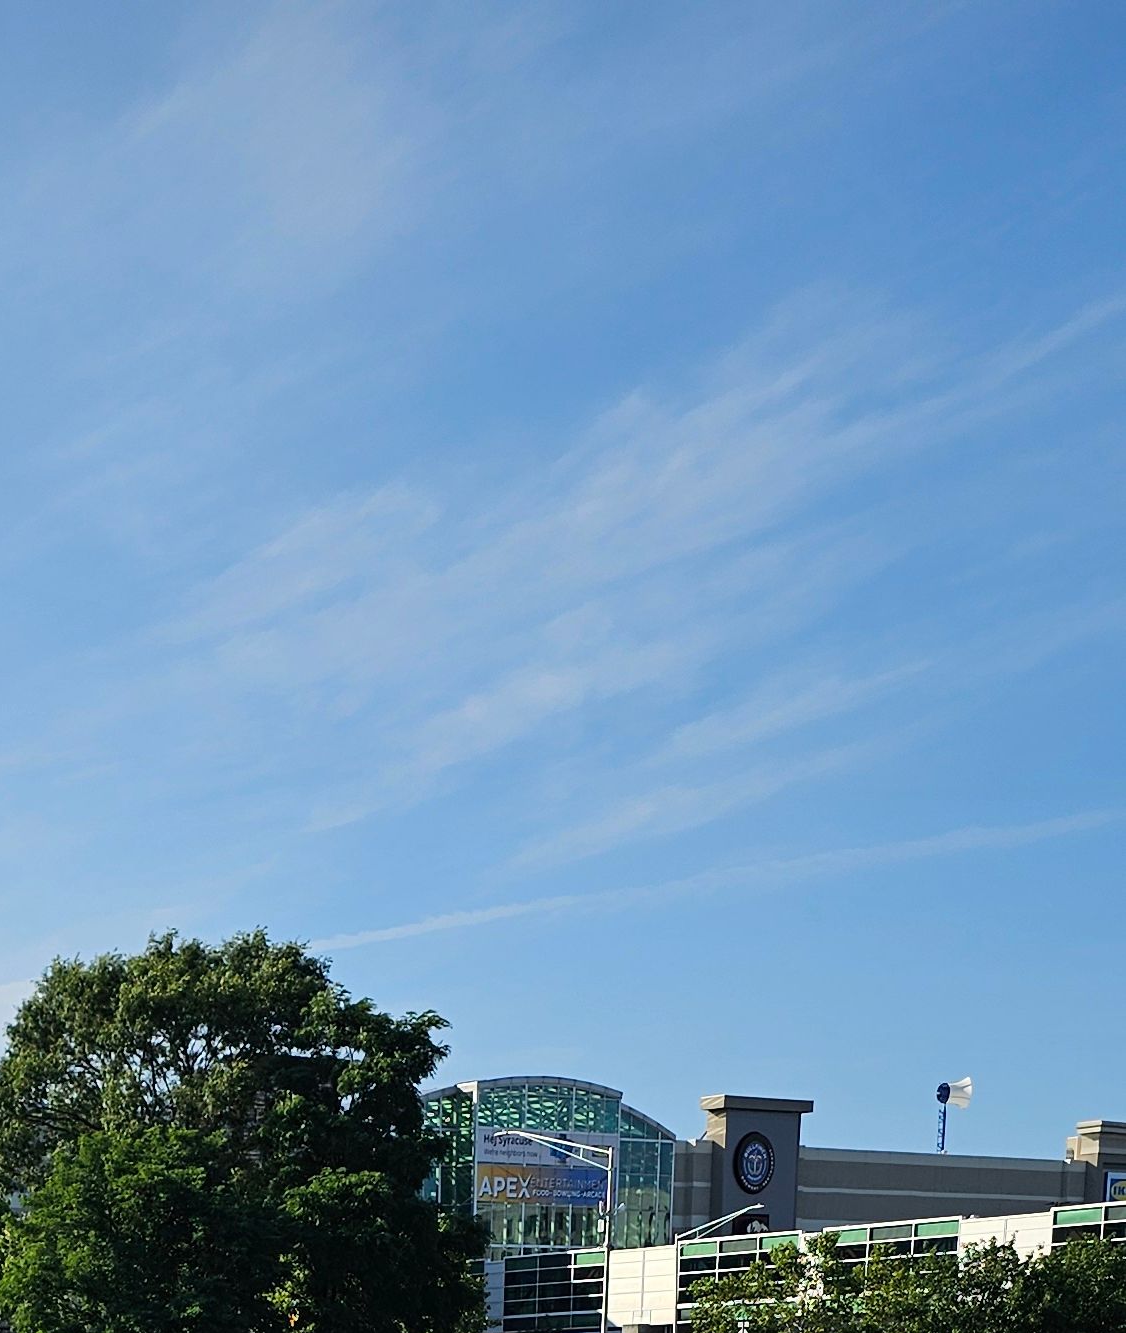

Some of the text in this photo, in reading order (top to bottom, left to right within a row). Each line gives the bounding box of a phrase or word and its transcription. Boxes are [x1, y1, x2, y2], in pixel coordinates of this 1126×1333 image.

[498, 1135, 533, 1147] Syracuse
[478, 1174, 532, 1199] APEX
[530, 1177, 605, 1189] ENTERTAINMEN
